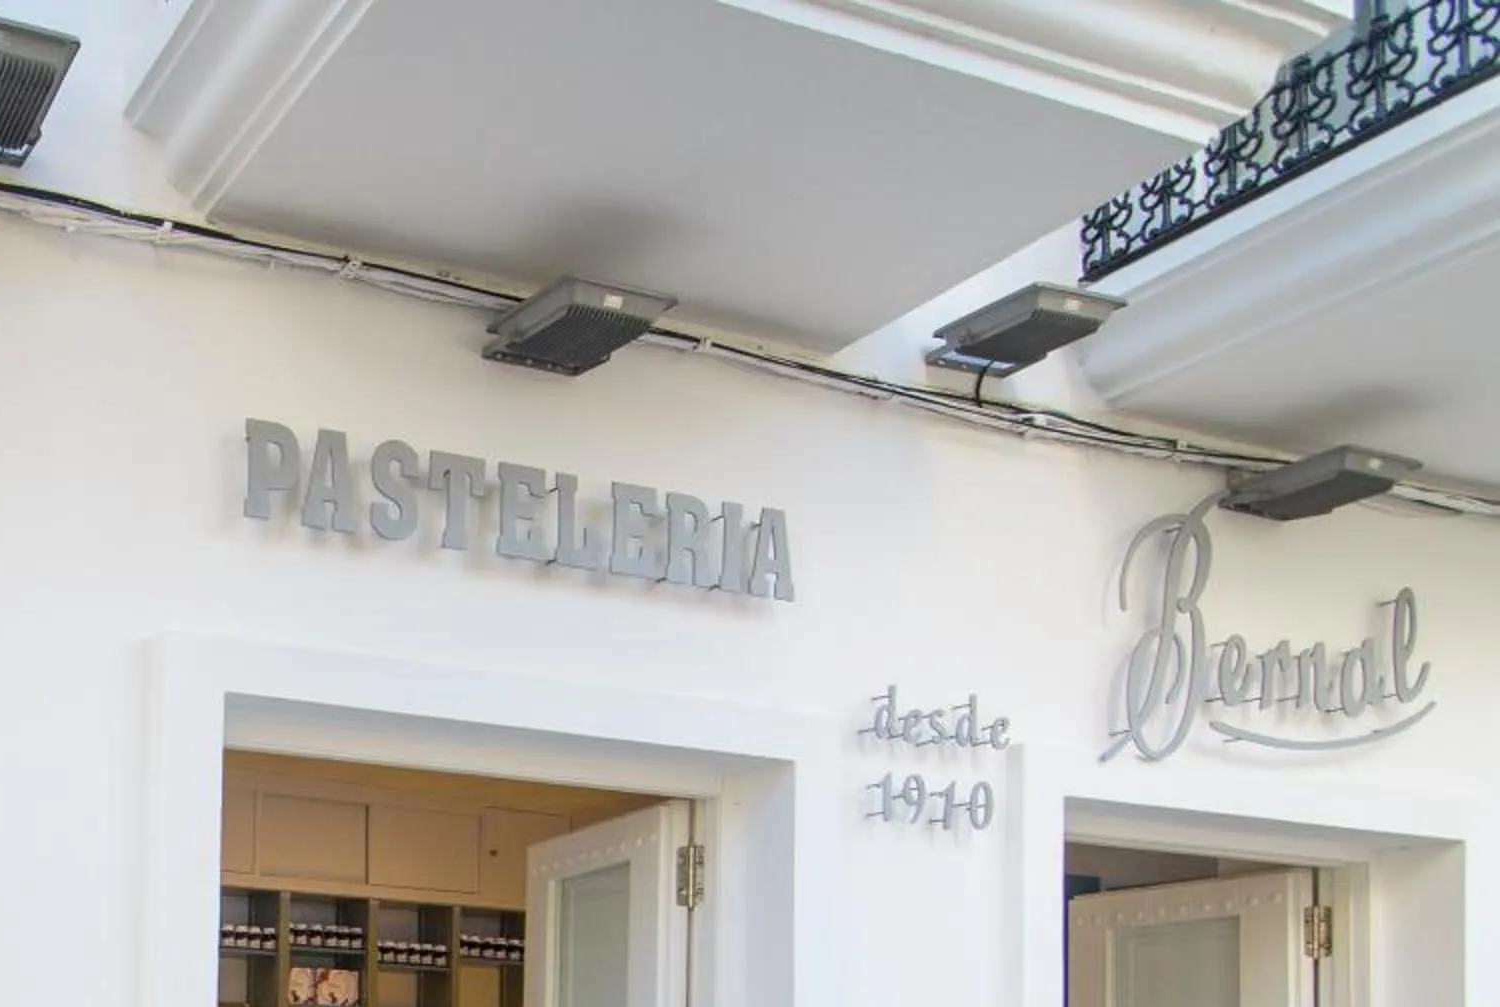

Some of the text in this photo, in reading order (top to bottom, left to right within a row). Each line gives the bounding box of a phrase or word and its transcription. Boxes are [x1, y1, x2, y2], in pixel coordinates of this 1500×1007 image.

[243, 417, 795, 603] PASTELERIA
[1098, 492, 1437, 763] Bernal
[874, 684, 1012, 751] desde
[879, 771, 994, 831] 1910
